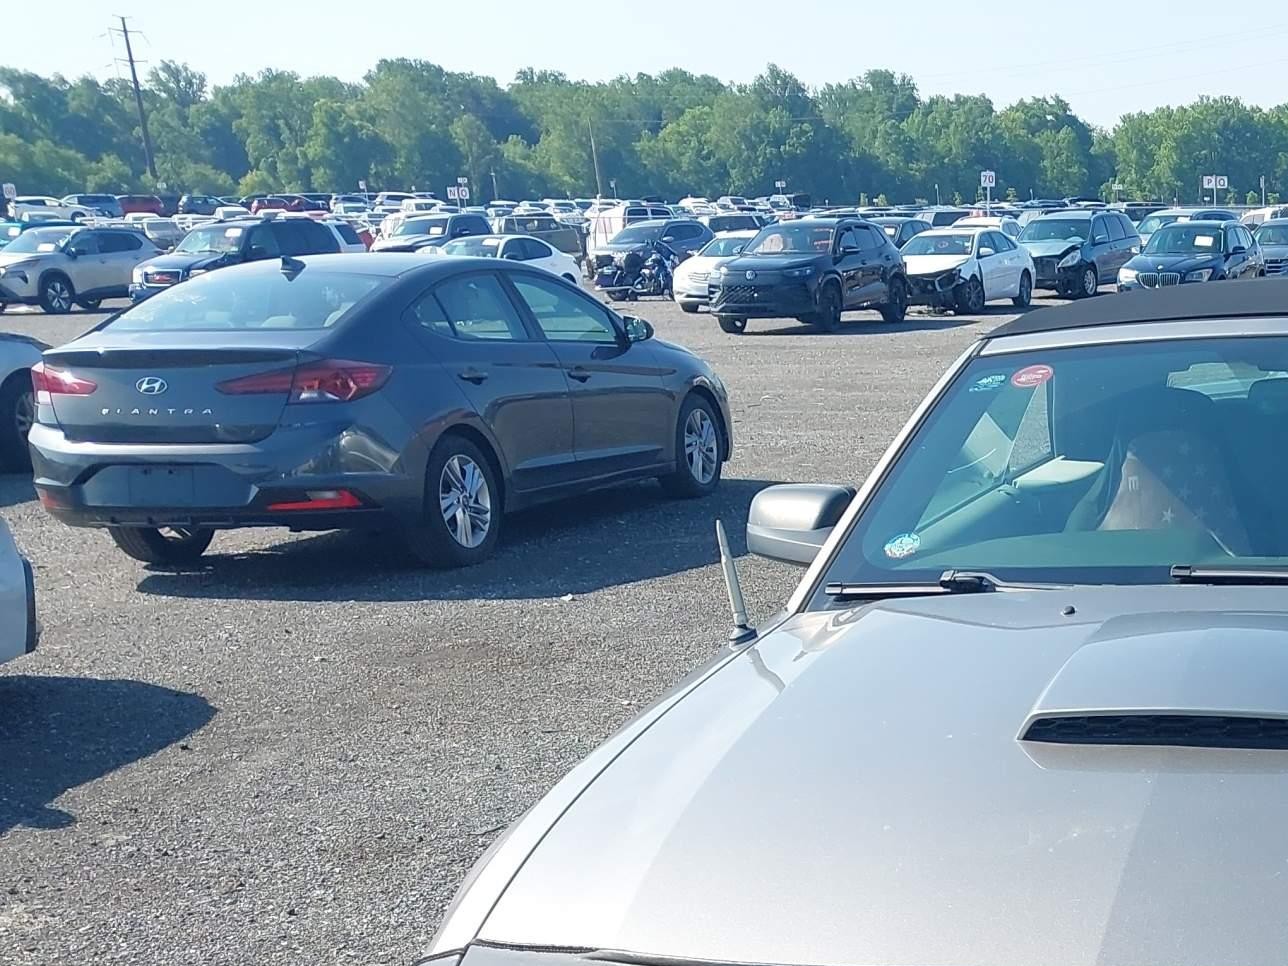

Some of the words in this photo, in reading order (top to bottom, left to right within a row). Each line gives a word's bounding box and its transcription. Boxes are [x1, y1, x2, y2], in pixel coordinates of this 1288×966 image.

[982, 174, 995, 185] 70
[1217, 178, 1226, 187] Q
[101, 407, 212, 416] ELANTRA
